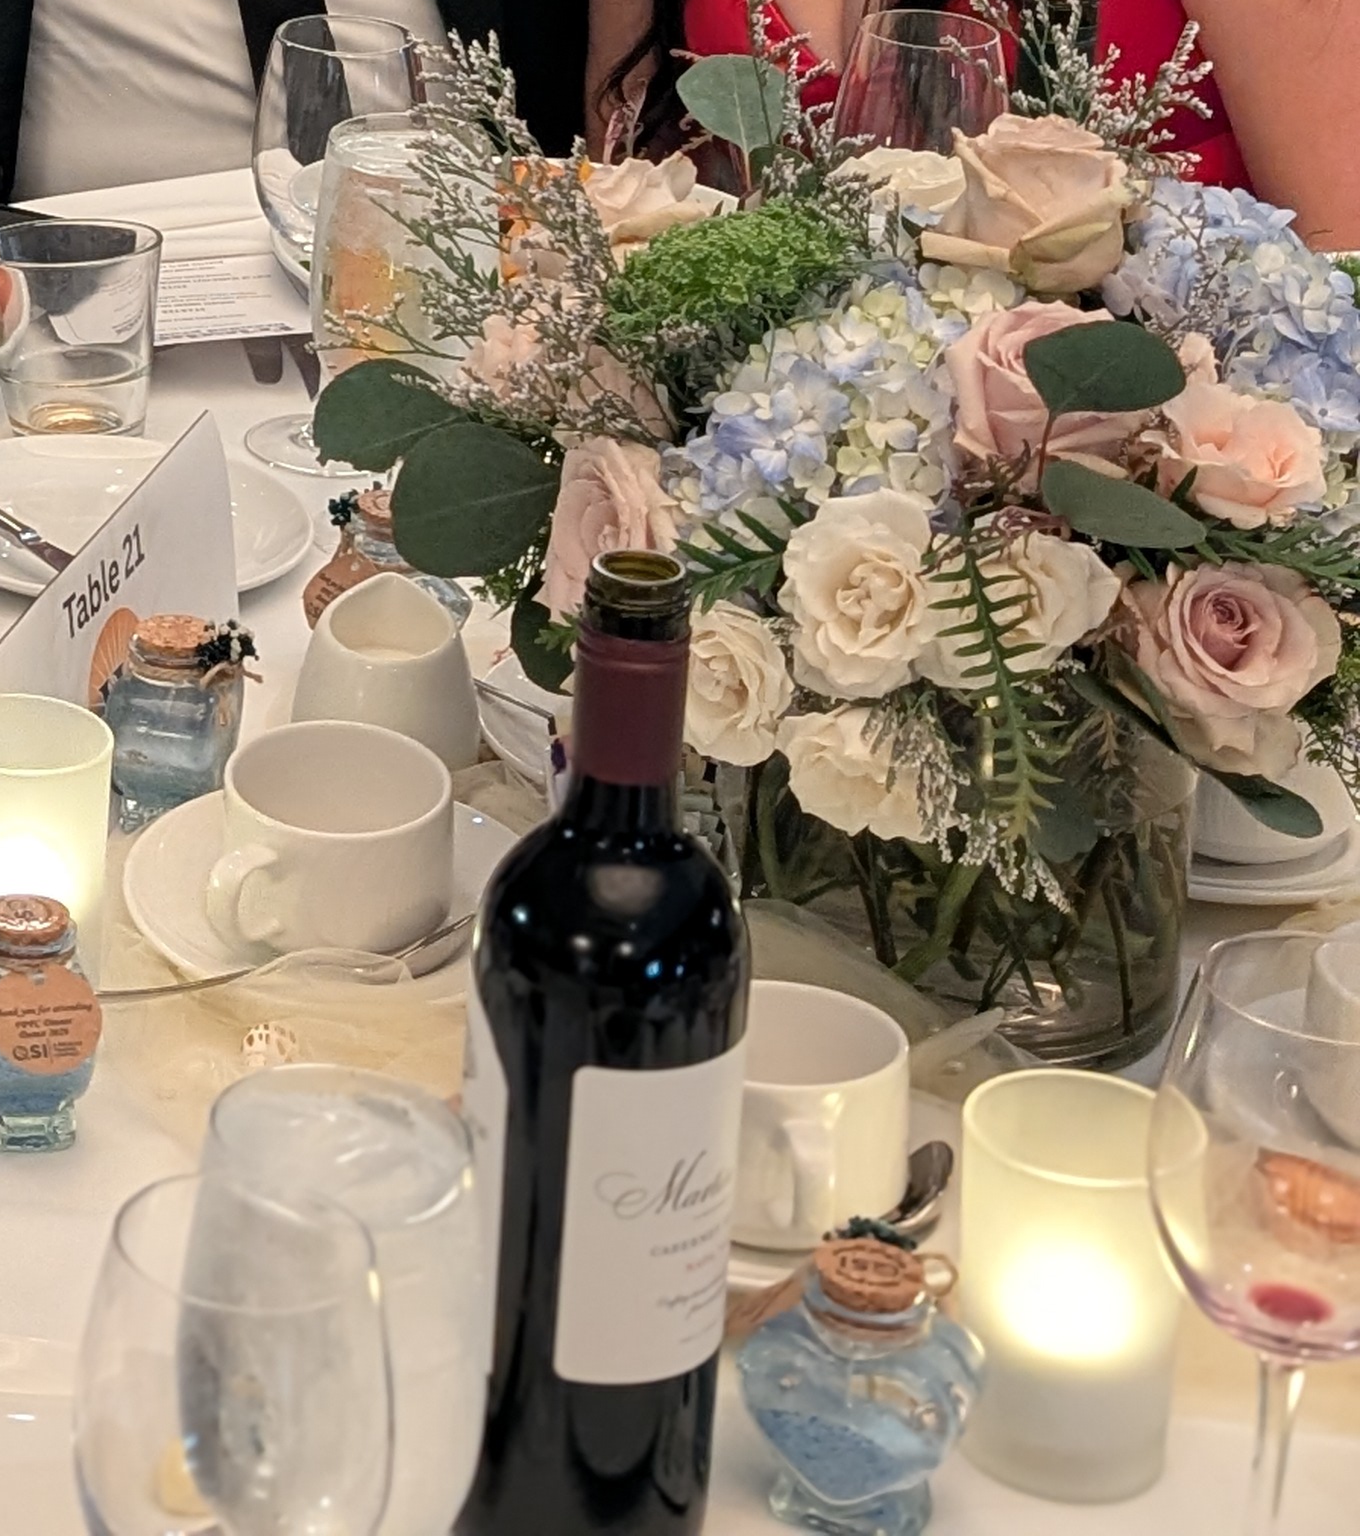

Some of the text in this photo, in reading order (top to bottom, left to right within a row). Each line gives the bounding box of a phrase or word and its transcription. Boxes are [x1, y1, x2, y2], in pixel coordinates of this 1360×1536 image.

[63, 524, 146, 638] Table 21
[12, 1044, 48, 1061] QSI
